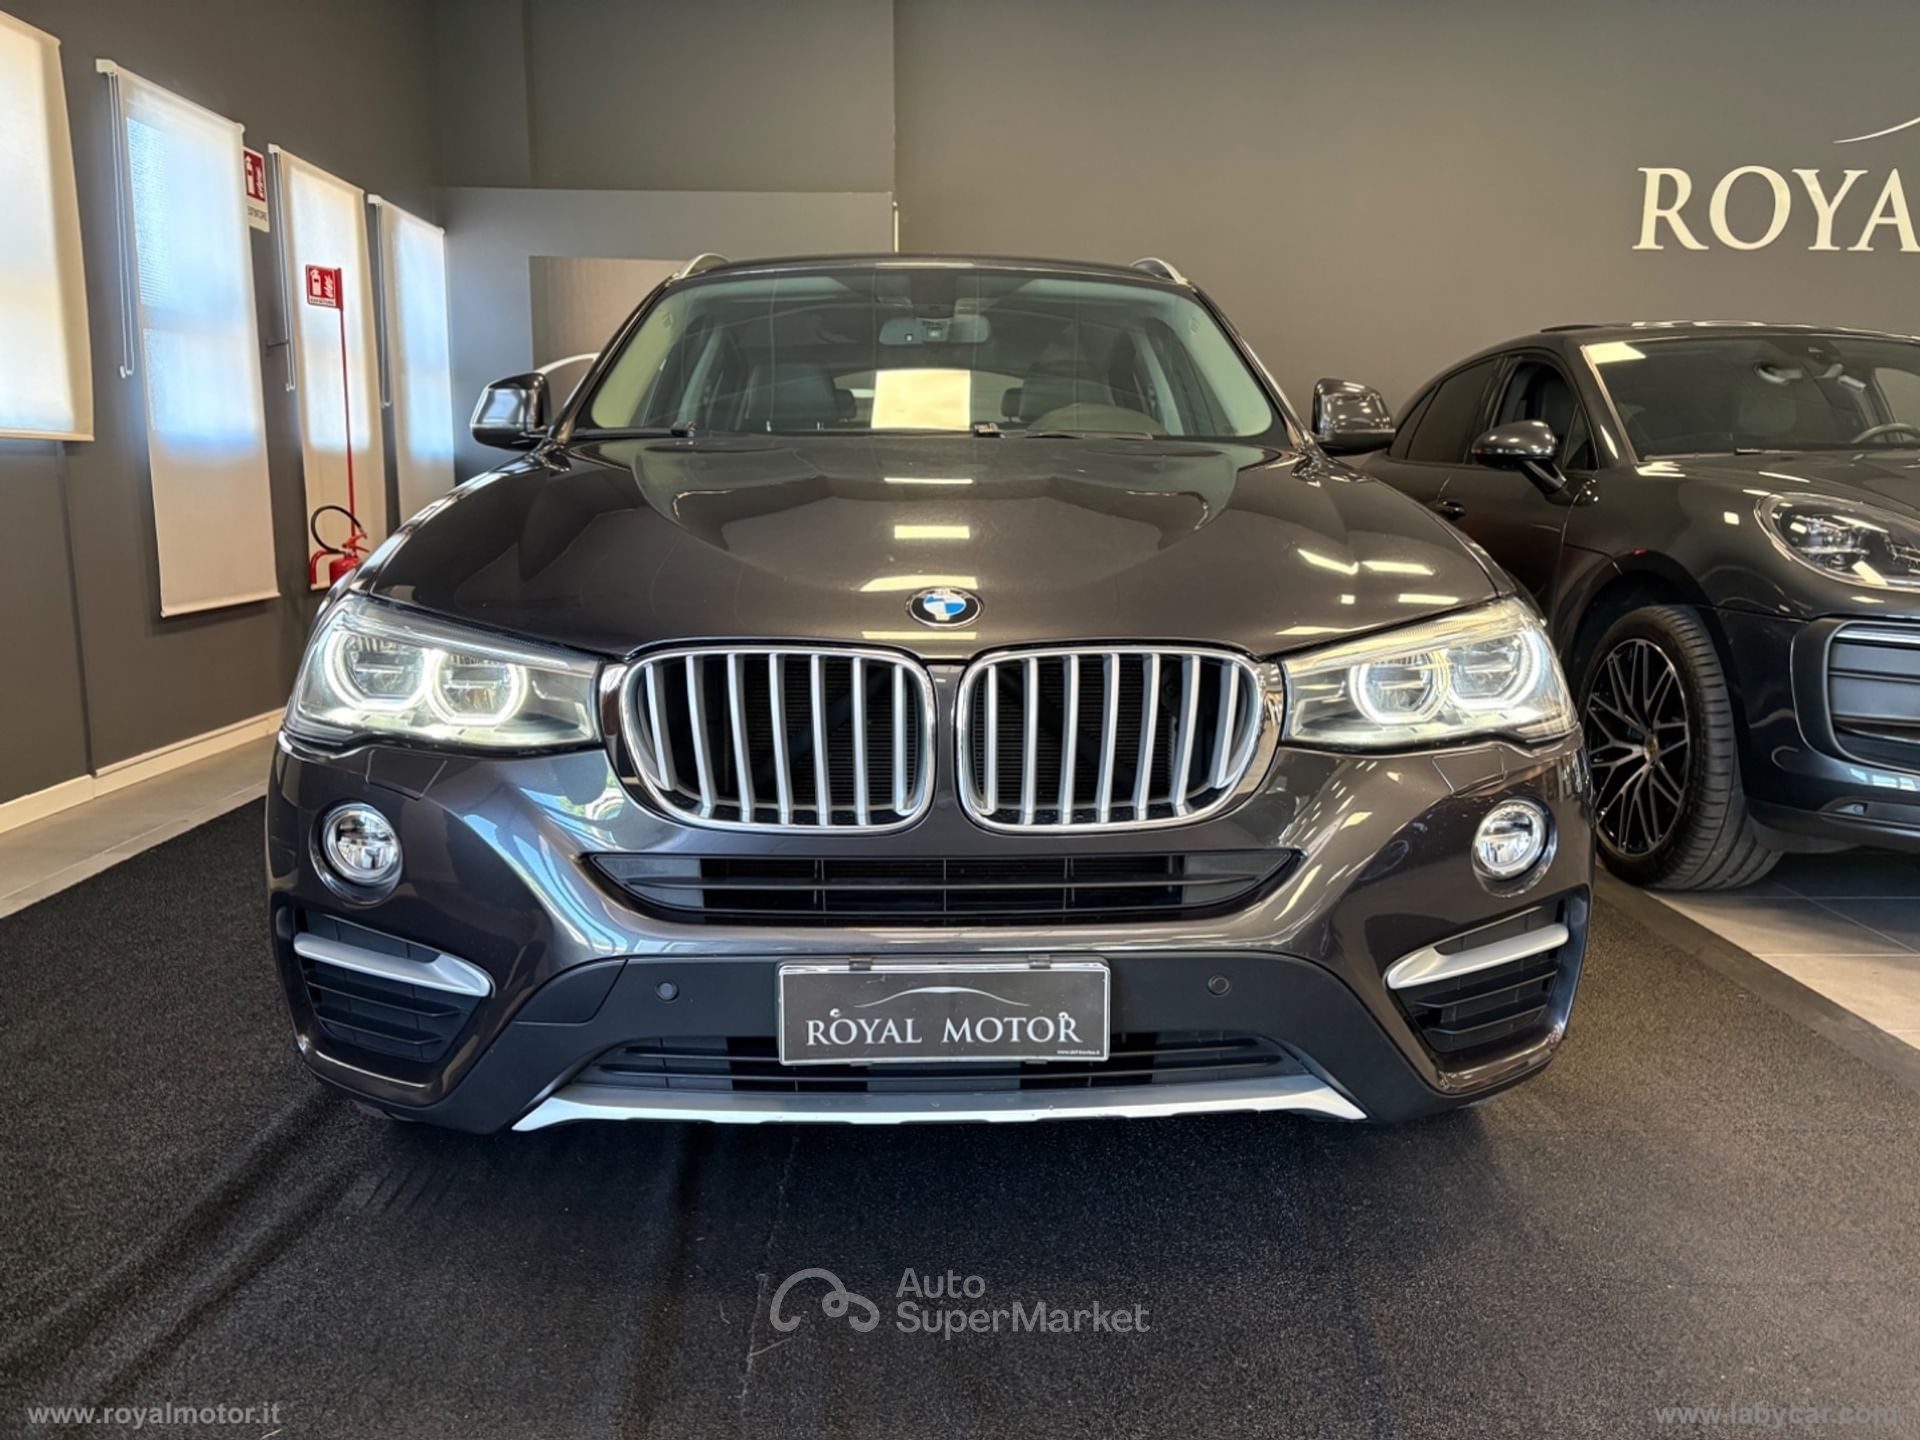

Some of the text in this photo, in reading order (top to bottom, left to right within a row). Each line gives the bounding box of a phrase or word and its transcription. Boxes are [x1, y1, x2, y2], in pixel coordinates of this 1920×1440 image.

[1632, 165, 1920, 252] ROYA
[806, 1017, 1082, 1046] ROYAL MOTOR
